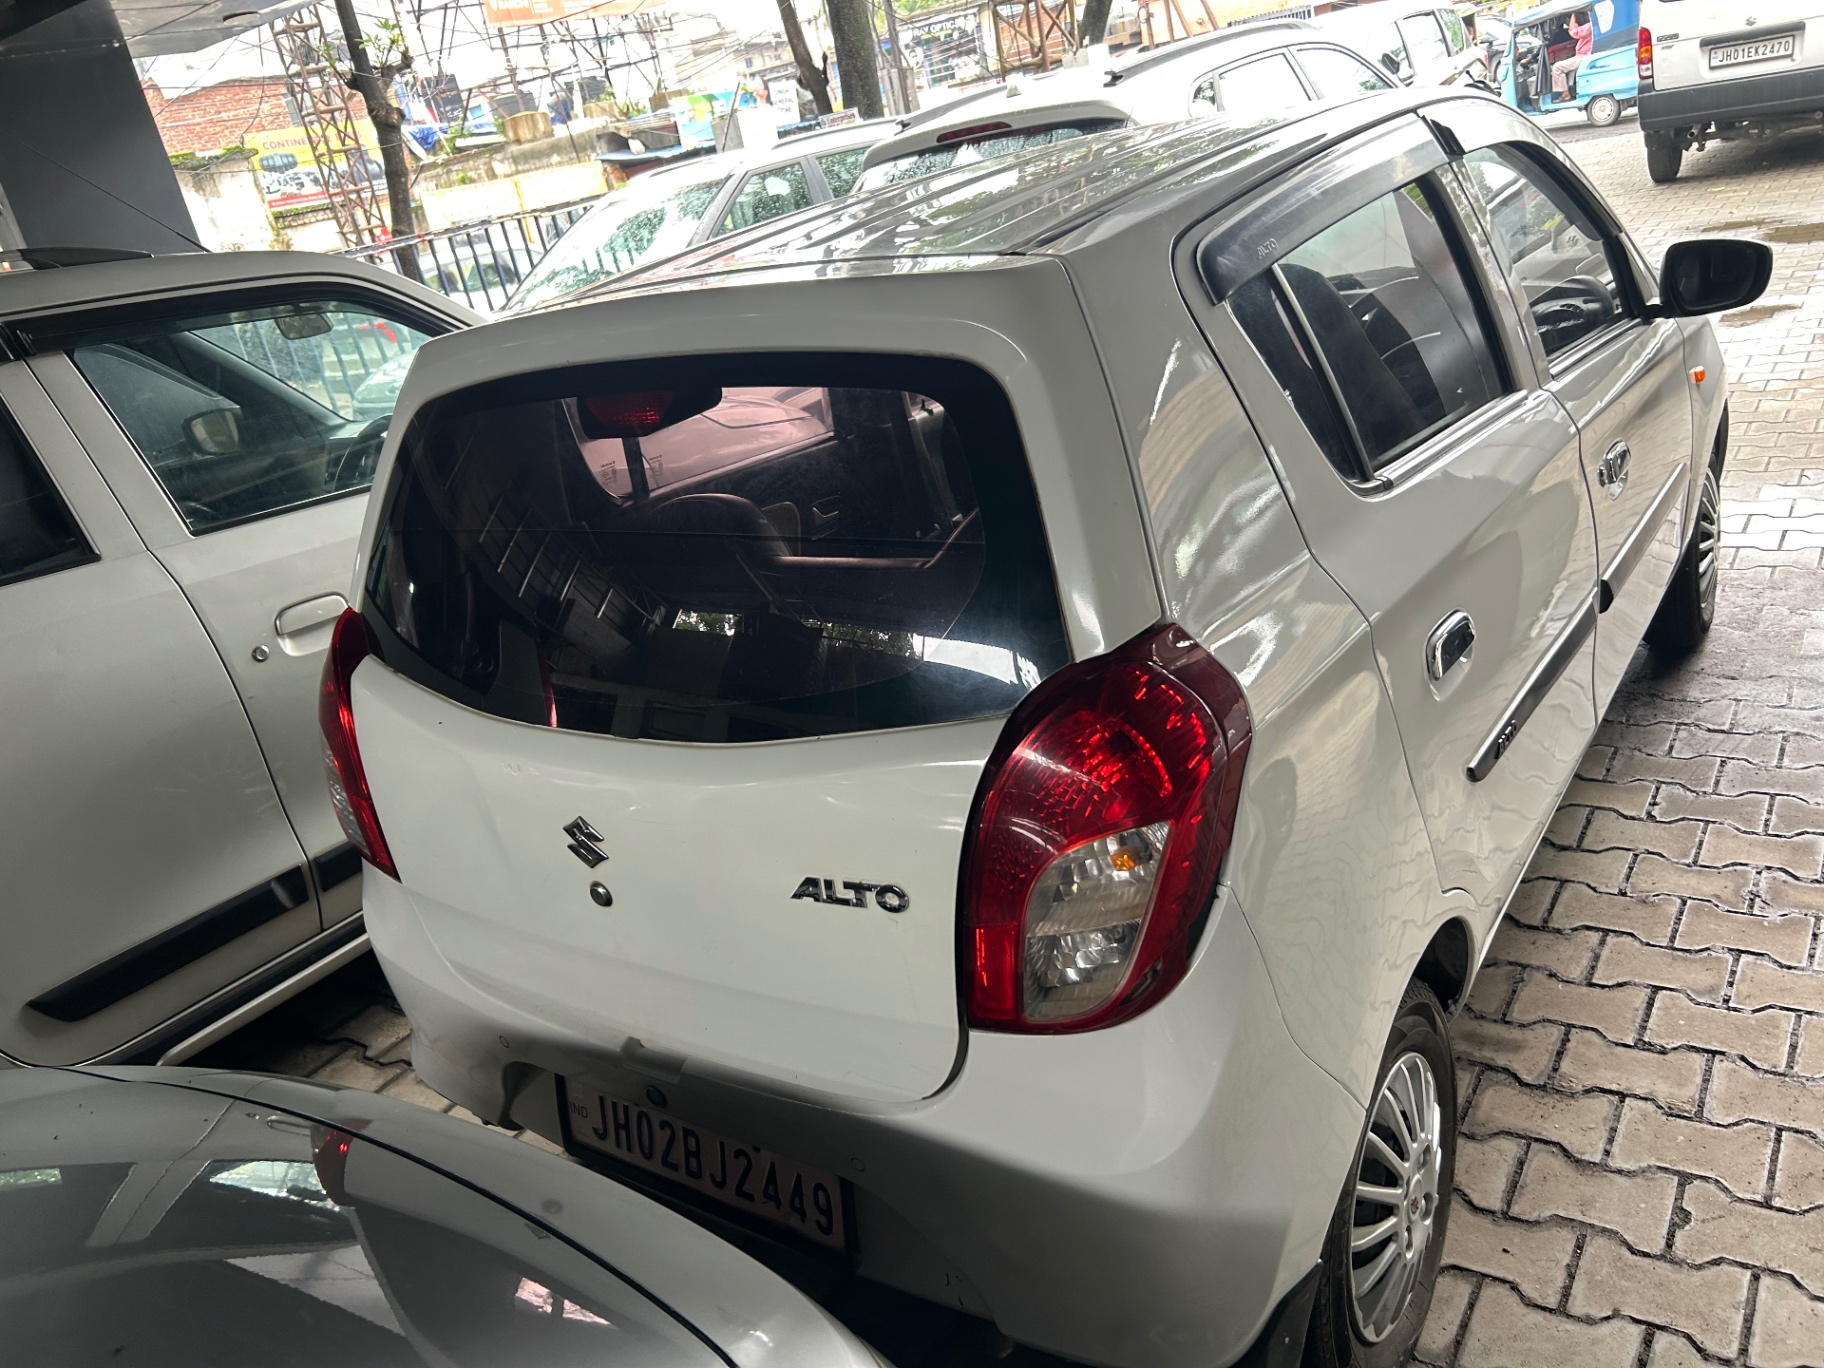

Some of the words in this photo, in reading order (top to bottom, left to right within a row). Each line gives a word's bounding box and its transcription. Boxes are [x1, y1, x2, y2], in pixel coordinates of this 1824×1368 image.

[1718, 40, 1790, 62] JH01EK2470
[1256, 238, 1279, 259] ALTO
[790, 876, 909, 913] ALTO
[568, 1101, 589, 1120] IND
[592, 1094, 834, 1236] JH02BJ2449
